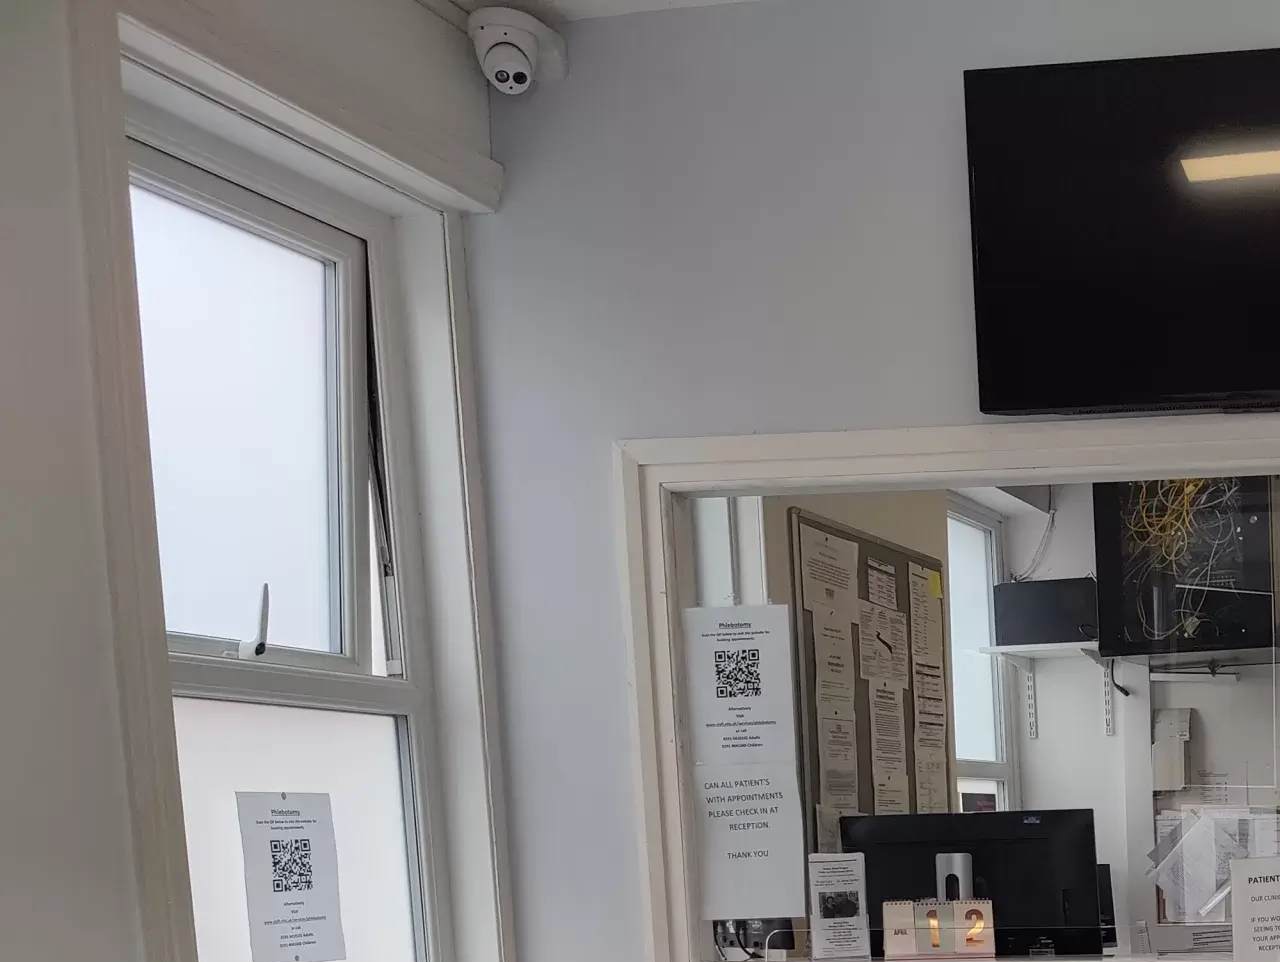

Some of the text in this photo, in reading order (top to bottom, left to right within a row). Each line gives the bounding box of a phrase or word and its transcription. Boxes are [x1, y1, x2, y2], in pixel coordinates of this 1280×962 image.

[704, 782, 719, 790] CAN
[734, 778, 770, 788] PATIENT'S
[706, 792, 784, 804] WITH APPOINTMENTS
[708, 810, 734, 818] PLEASE
[735, 808, 759, 816] CHECK
[769, 806, 779, 814] AT
[729, 821, 771, 831] RECEPTION.
[727, 851, 752, 859] THANK
[1248, 874, 1280, 884] PATIENT
[926, 908, 985, 948] 1 2
[1253, 925, 1274, 933] SEEING
